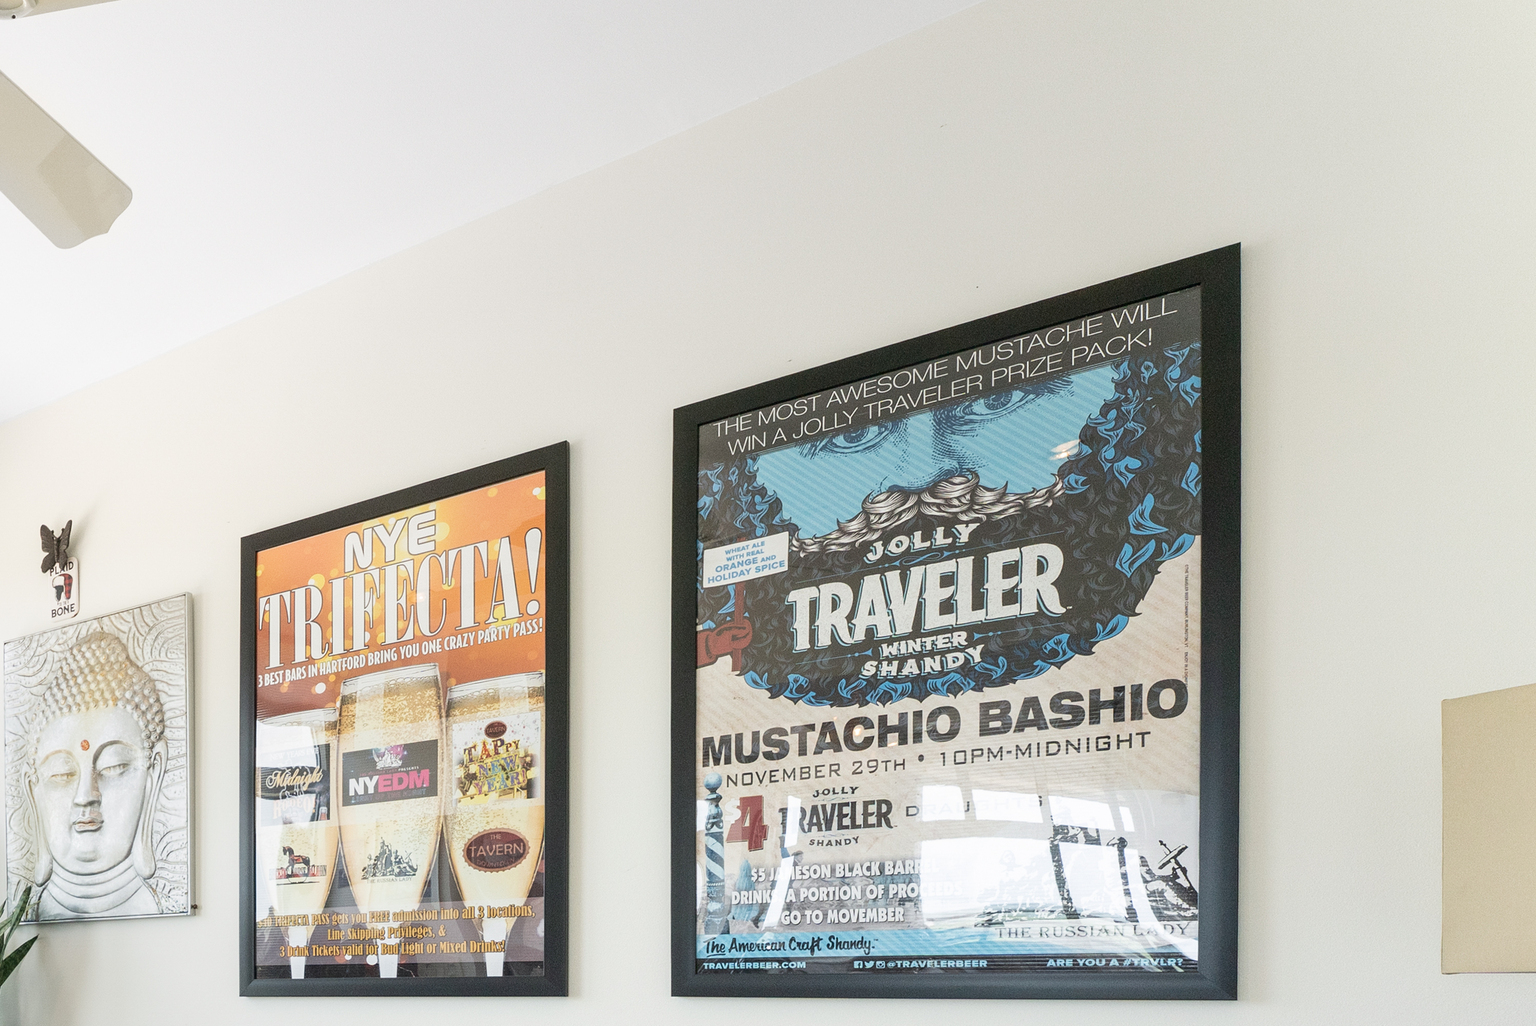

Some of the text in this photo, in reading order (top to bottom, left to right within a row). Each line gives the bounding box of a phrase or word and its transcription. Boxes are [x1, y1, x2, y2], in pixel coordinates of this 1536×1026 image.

[713, 298, 1178, 438] THE MOST AWESOME MUSTACHE WILL
[728, 328, 1153, 456] WIN A JOLLY TRAVELER PRIZE PACK!
[344, 508, 437, 574] NYE
[724, 540, 766, 555] WHEAT ALE
[864, 523, 980, 564] JOLLY
[715, 554, 777, 573] ORANGE AND
[726, 548, 765, 562] WITH REAL
[707, 560, 785, 584] HOLIDAY SPICE
[258, 527, 543, 670] TRIFECTA!
[785, 542, 1068, 653] TRAVELER
[51, 603, 76, 619] BONE
[258, 617, 543, 687] 3 BEST BARS IN HARTFORD BRING YOU ONE CRAZY PARTY PASS!
[878, 631, 968, 660] WINTER
[860, 645, 985, 679] SHANDY
[702, 678, 1189, 768] MUSTACHIO BASHIO
[463, 738, 521, 763] TAPPY
[726, 731, 1152, 788] NOVEMBER 29TH 10PM-MIDNIGHT
[478, 754, 518, 776] NEW
[265, 766, 324, 791] Midnight
[348, 769, 430, 796] NYEDM
[473, 769, 527, 795] YEAR!
[812, 786, 860, 798] JOLLY
[724, 795, 769, 852] $4
[778, 799, 895, 835] TRAVELER
[468, 842, 524, 858] TAVERN
[809, 836, 860, 847] SHANDY
[751, 867, 766, 883] $5
[835, 860, 881, 880] BLACK
[785, 888, 796, 903] A
[800, 885, 863, 902] PORTION
[865, 884, 885, 900] OF
[275, 914, 310, 928] TRIFECTA
[311, 913, 330, 926] PASS
[332, 912, 349, 926] gets
[351, 913, 367, 925] you
[369, 910, 390, 923] FREE
[392, 909, 438, 922] admission
[440, 907, 460, 920] into
[462, 906, 475, 919] all
[478, 906, 485, 919] 3
[487, 904, 536, 918] locations,
[780, 907, 906, 926] GO TO MOVEMBER
[327, 924, 447, 941] Line Skipping Privileges, &
[995, 922, 1191, 939] THE RUSSIAN LADY
[279, 940, 506, 958] 3 Drink Tickets valid for Bud Light or Mixed Drinks!
[704, 937, 726, 957] The
[728, 937, 786, 953] American
[788, 936, 823, 956] Craft
[703, 960, 806, 970] TRAVELERBEER.COM
[887, 959, 988, 969] @TRAVELERBEER
[1046, 957, 1184, 968] ARE YOU A #TRVLR?
